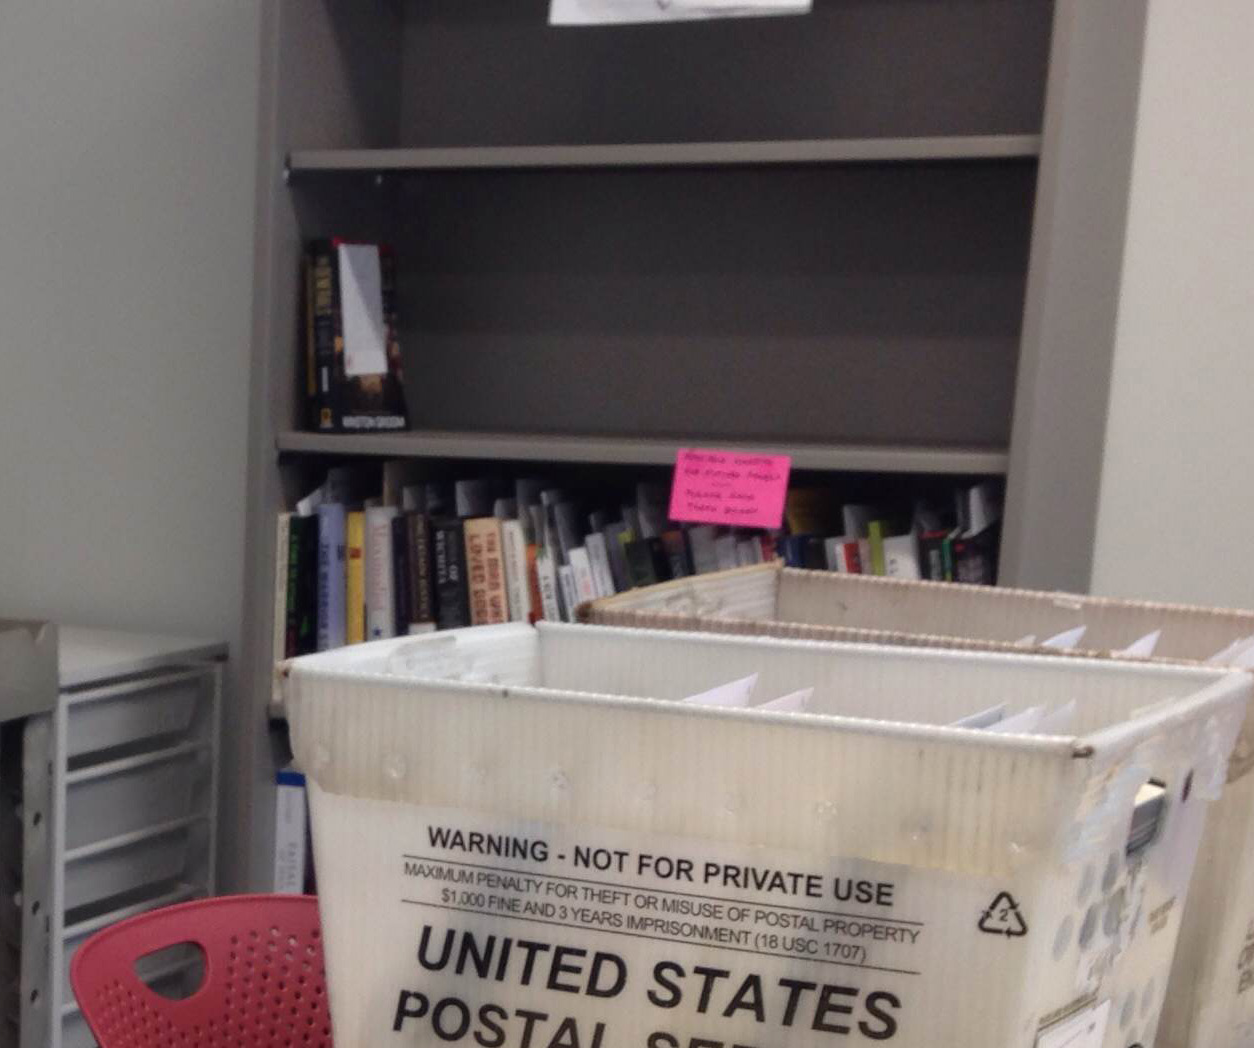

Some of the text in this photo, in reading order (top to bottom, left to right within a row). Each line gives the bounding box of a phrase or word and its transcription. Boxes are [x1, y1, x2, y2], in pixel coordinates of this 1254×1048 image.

[403, 861, 921, 945] MAXIMUM PENALTY FOR THEFT OR MISUSE OF POSTAL PROPERTY
[428, 825, 549, 863] WARNING
[573, 845, 629, 873] NOT
[637, 853, 695, 882] FOR
[703, 861, 824, 898] PRIVATE
[833, 877, 895, 907] USE
[441, 887, 868, 964] $1,000 FINE AND 3 YEARS IMPRISONMENT (18 USC 1707)
[417, 924, 902, 1040] UNITED STATES
